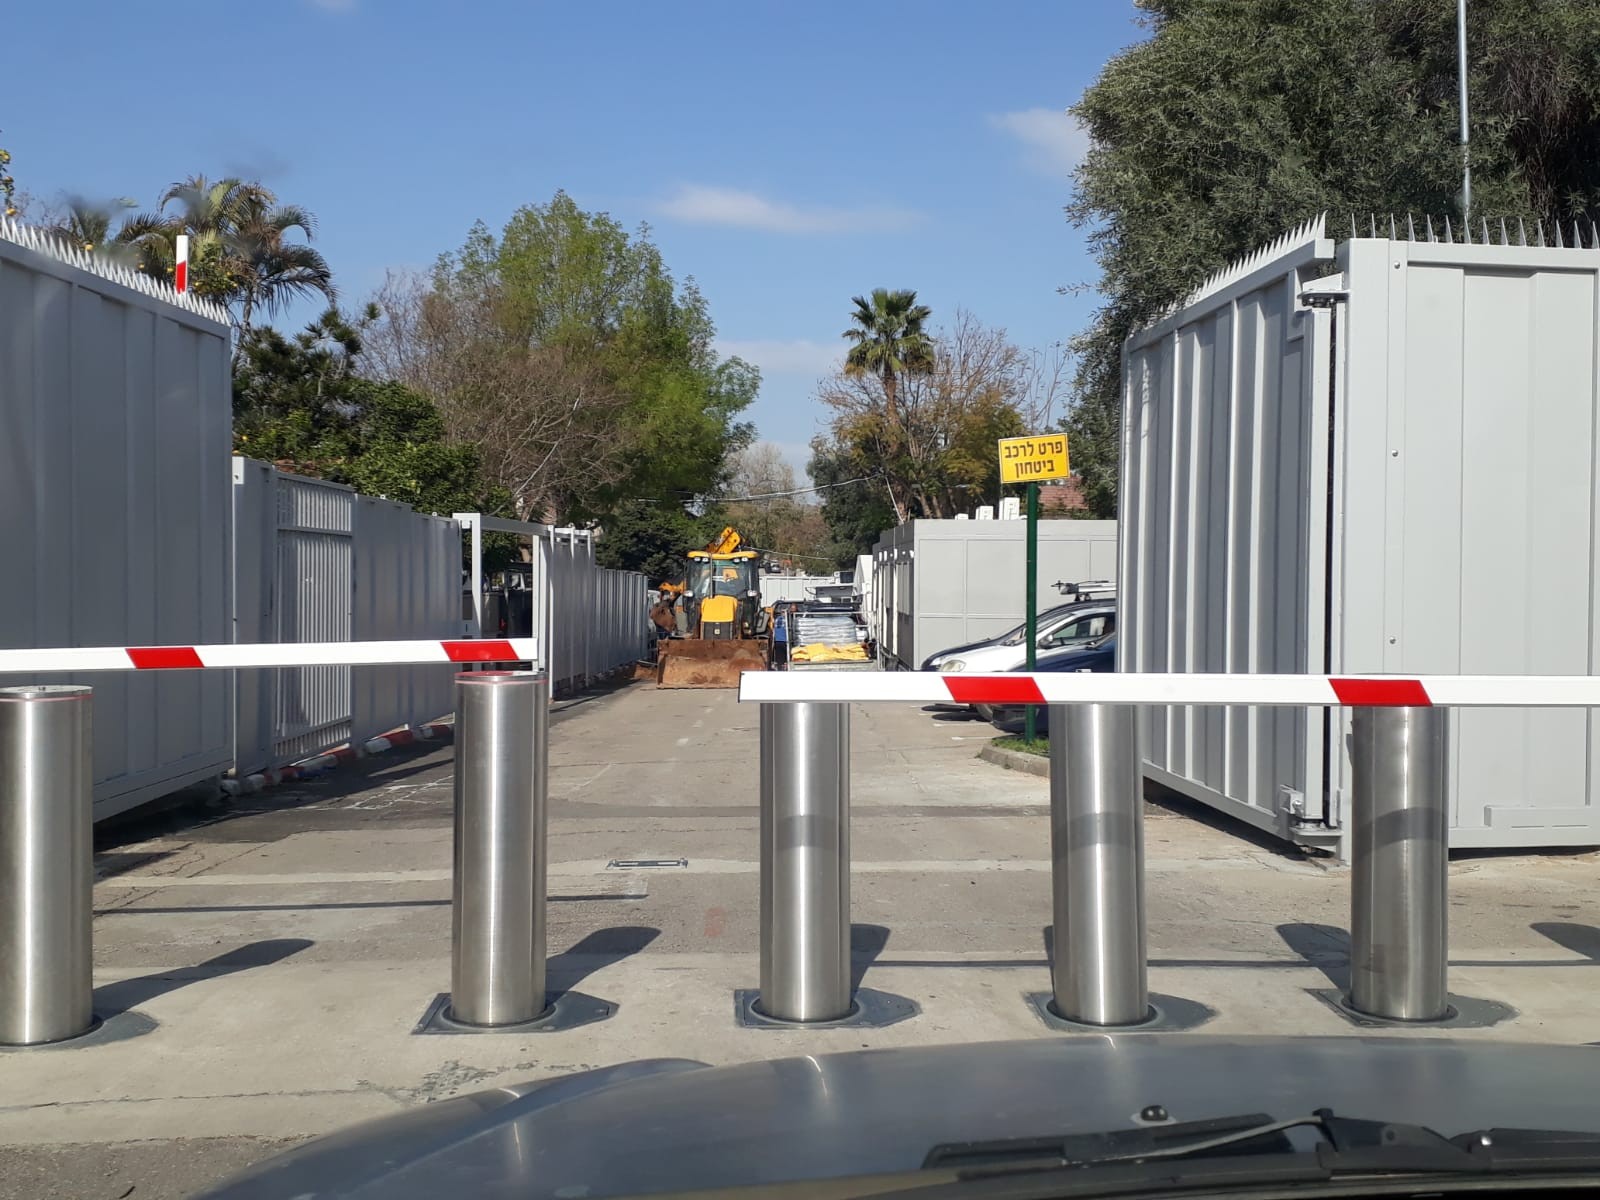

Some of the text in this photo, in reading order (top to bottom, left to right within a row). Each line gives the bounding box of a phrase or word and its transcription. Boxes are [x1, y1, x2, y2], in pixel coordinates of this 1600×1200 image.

[1004, 441, 1063, 459] פרט לרכב
[1015, 459, 1055, 478] ביטחון
